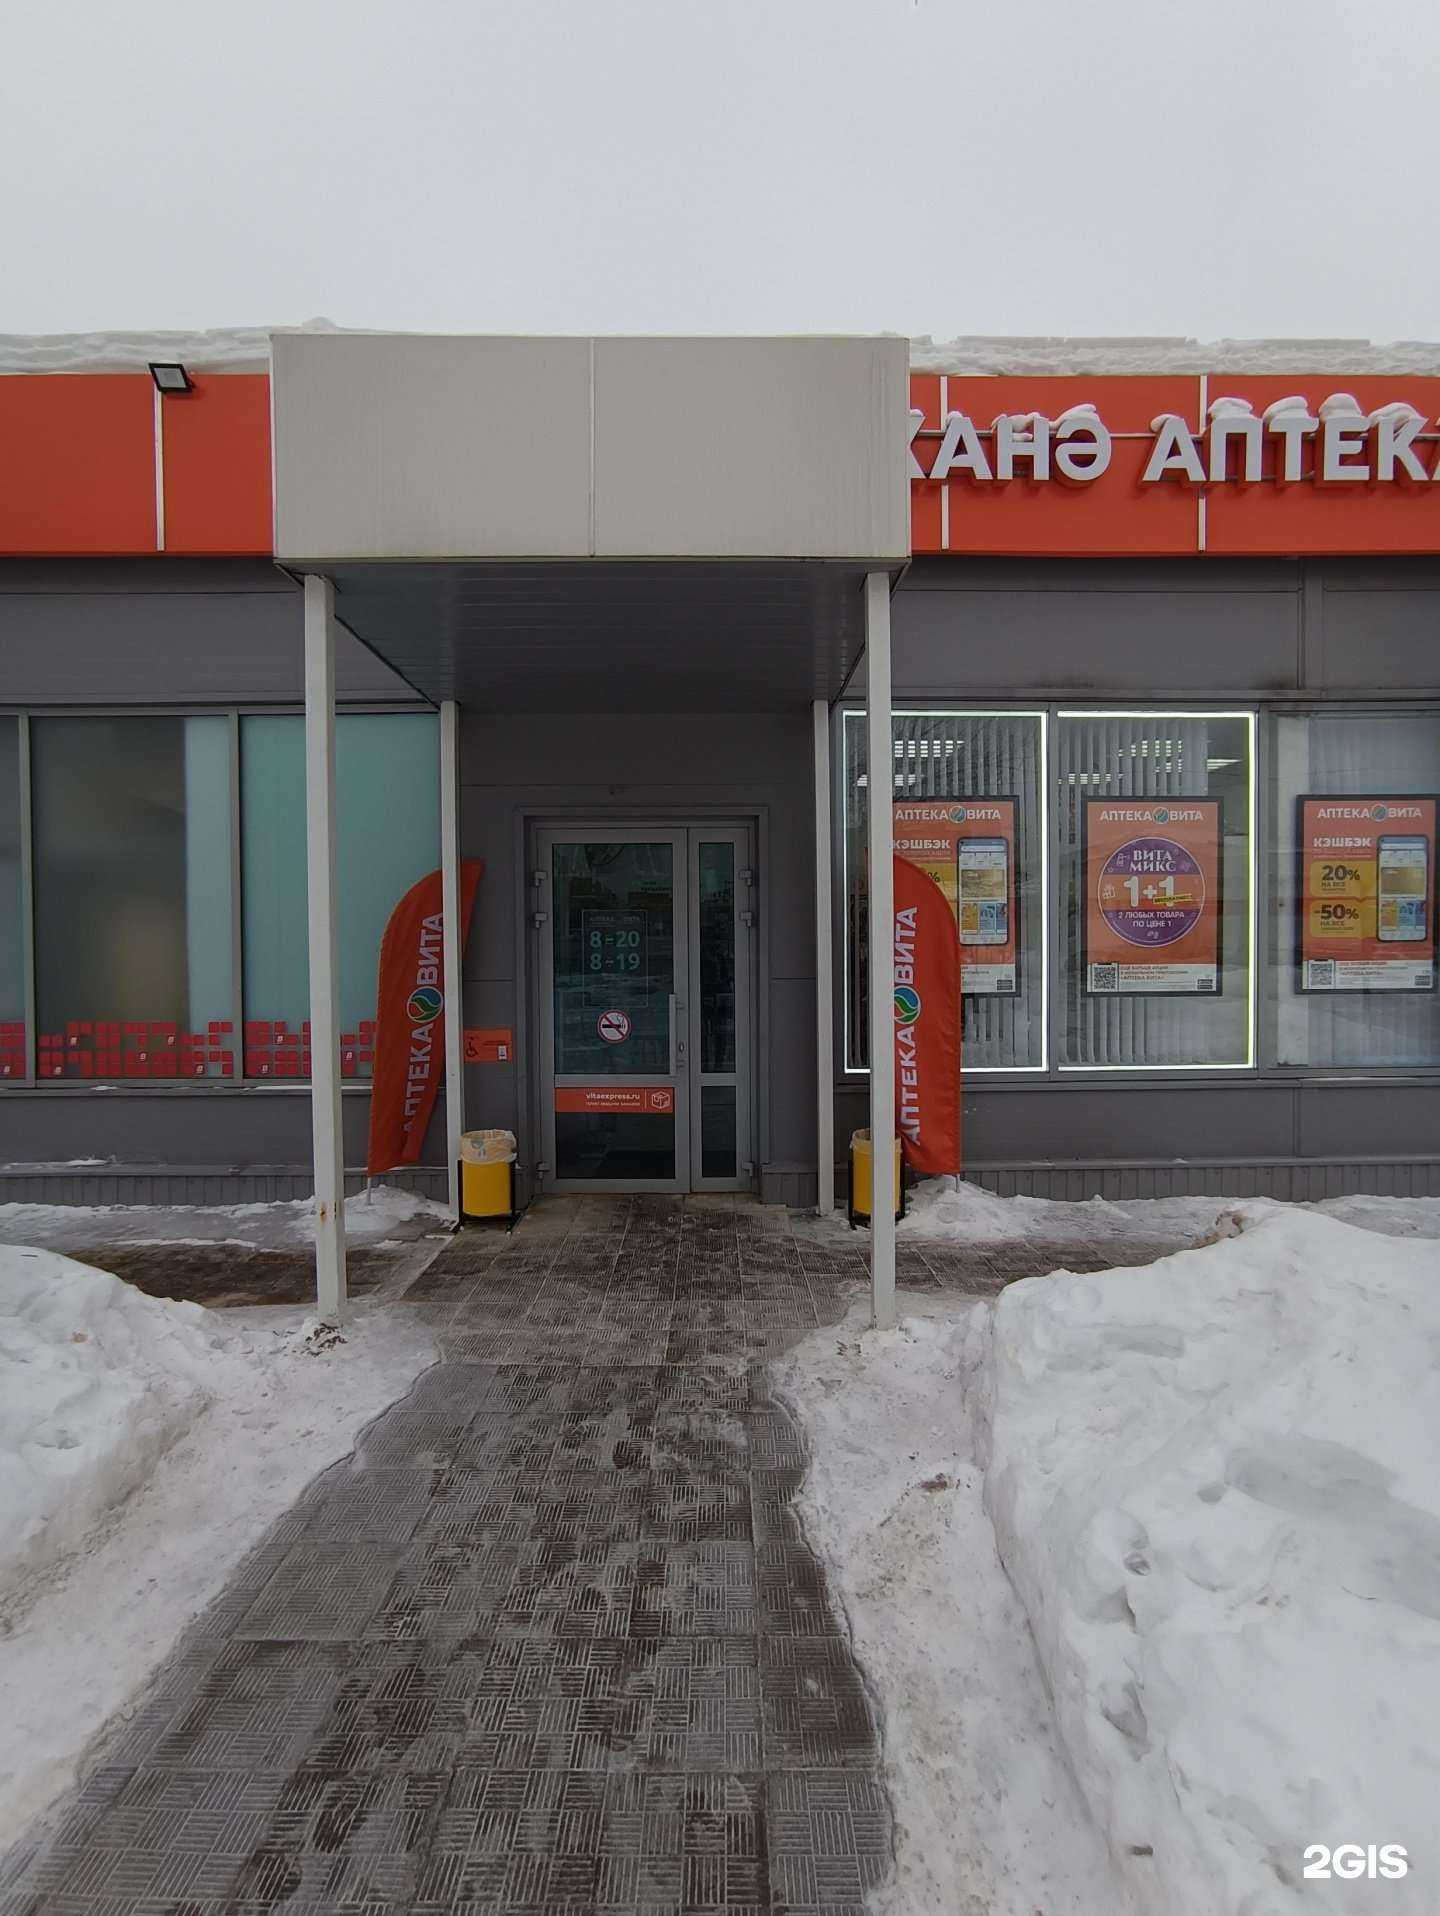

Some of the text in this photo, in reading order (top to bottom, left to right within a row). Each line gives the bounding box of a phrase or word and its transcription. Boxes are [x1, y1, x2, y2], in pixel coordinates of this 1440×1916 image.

[1142, 417, 1440, 481] АПТЕК
[895, 809, 1001, 820] АПТЕКА ВИТА
[1100, 810, 1203, 821] АПТЕКА ВИТА
[1317, 807, 1423, 818] АПТЕКА ВИТА
[893, 839, 950, 849] КЭШБЭК
[1313, 837, 1372, 848] КЭШБЭК
[1133, 850, 1172, 861] ВИТА
[1129, 861, 1176, 872] МИКС
[1321, 864, 1361, 881] 20%
[1123, 875, 1175, 907] 1+1
[1125, 911, 1155, 919] ЛЮБЫХ
[1132, 920, 1144, 928] ПО
[1146, 920, 1166, 929] ЦЕНЕ
[416, 912, 443, 985] ВИТА
[894, 906, 918, 985] ВИТА
[585, 1092, 641, 1101] vitaexpress.ru
